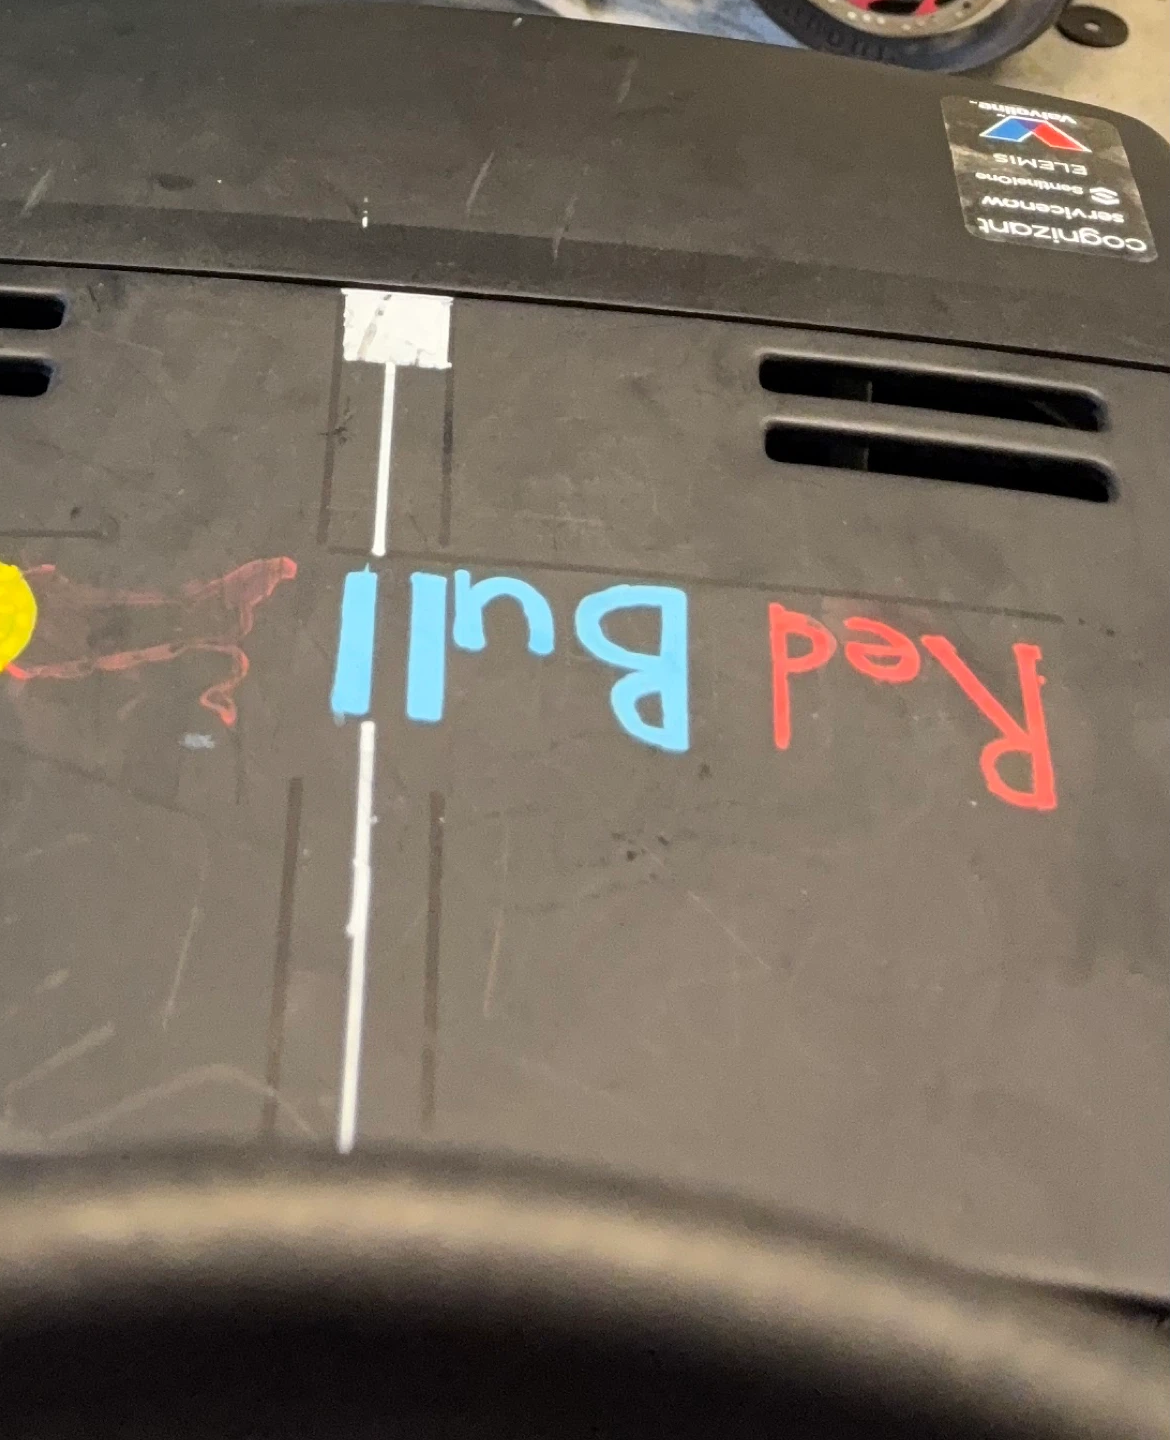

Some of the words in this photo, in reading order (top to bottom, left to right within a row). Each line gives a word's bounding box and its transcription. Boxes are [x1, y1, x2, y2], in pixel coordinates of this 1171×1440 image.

[978, 102, 1077, 125] Valvoline
[992, 152, 1088, 176] ELEMIS
[981, 195, 1125, 224] servicenow
[976, 217, 1147, 252] cognizant
[330, 567, 690, 753] Bull
[769, 603, 1057, 810] Red
